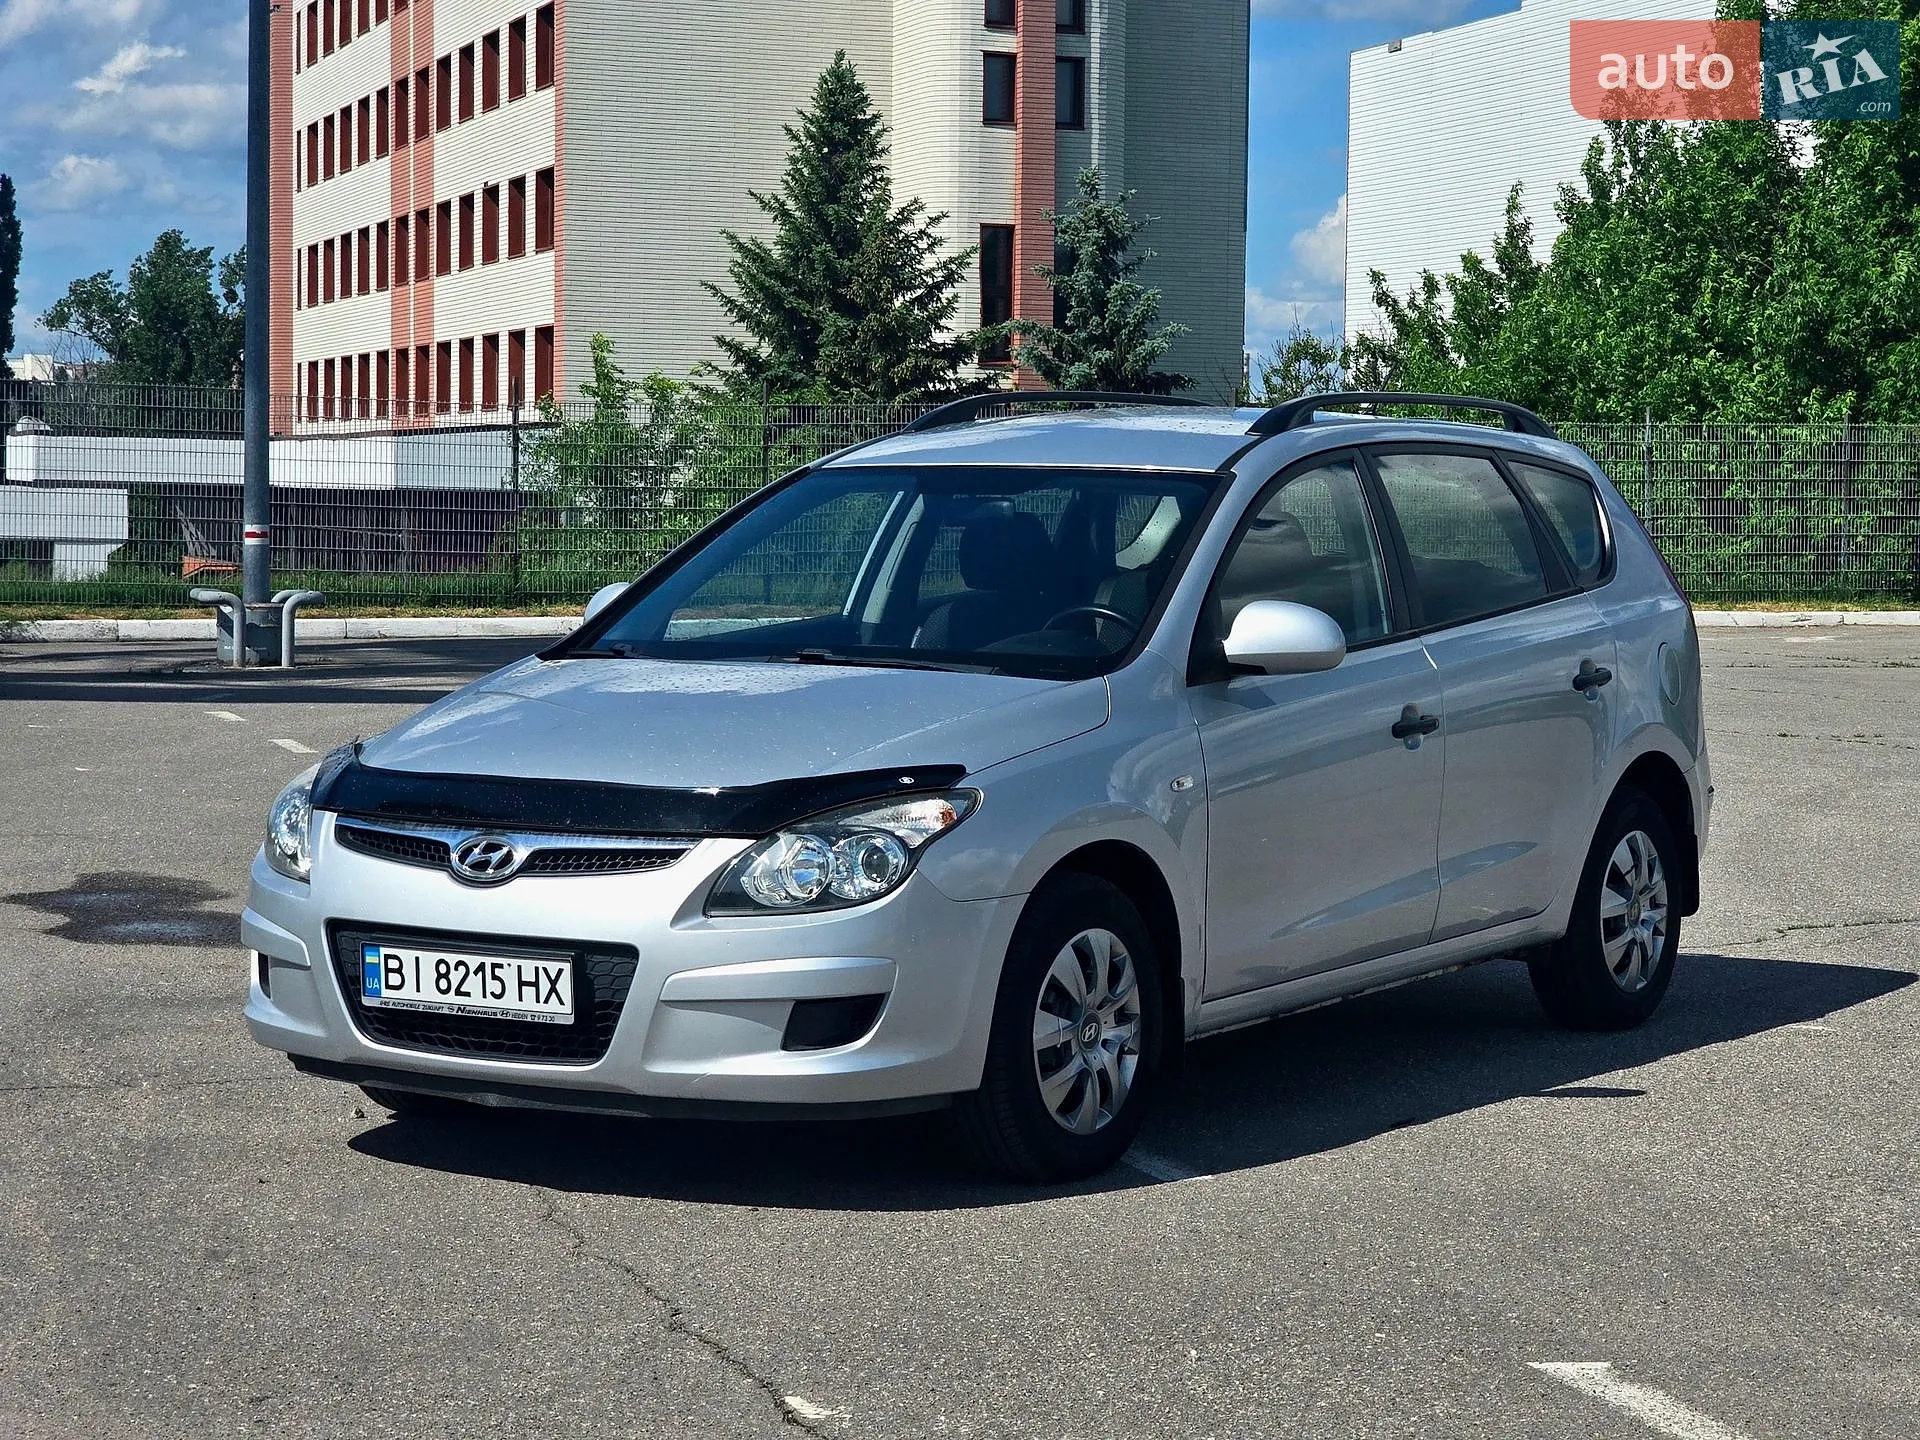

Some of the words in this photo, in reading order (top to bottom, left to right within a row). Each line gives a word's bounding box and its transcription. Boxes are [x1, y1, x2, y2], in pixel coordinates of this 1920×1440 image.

[366, 977, 379, 989] UA
[383, 953, 421, 993] BI
[434, 957, 507, 1000] 8215
[516, 963, 565, 1006] HX
